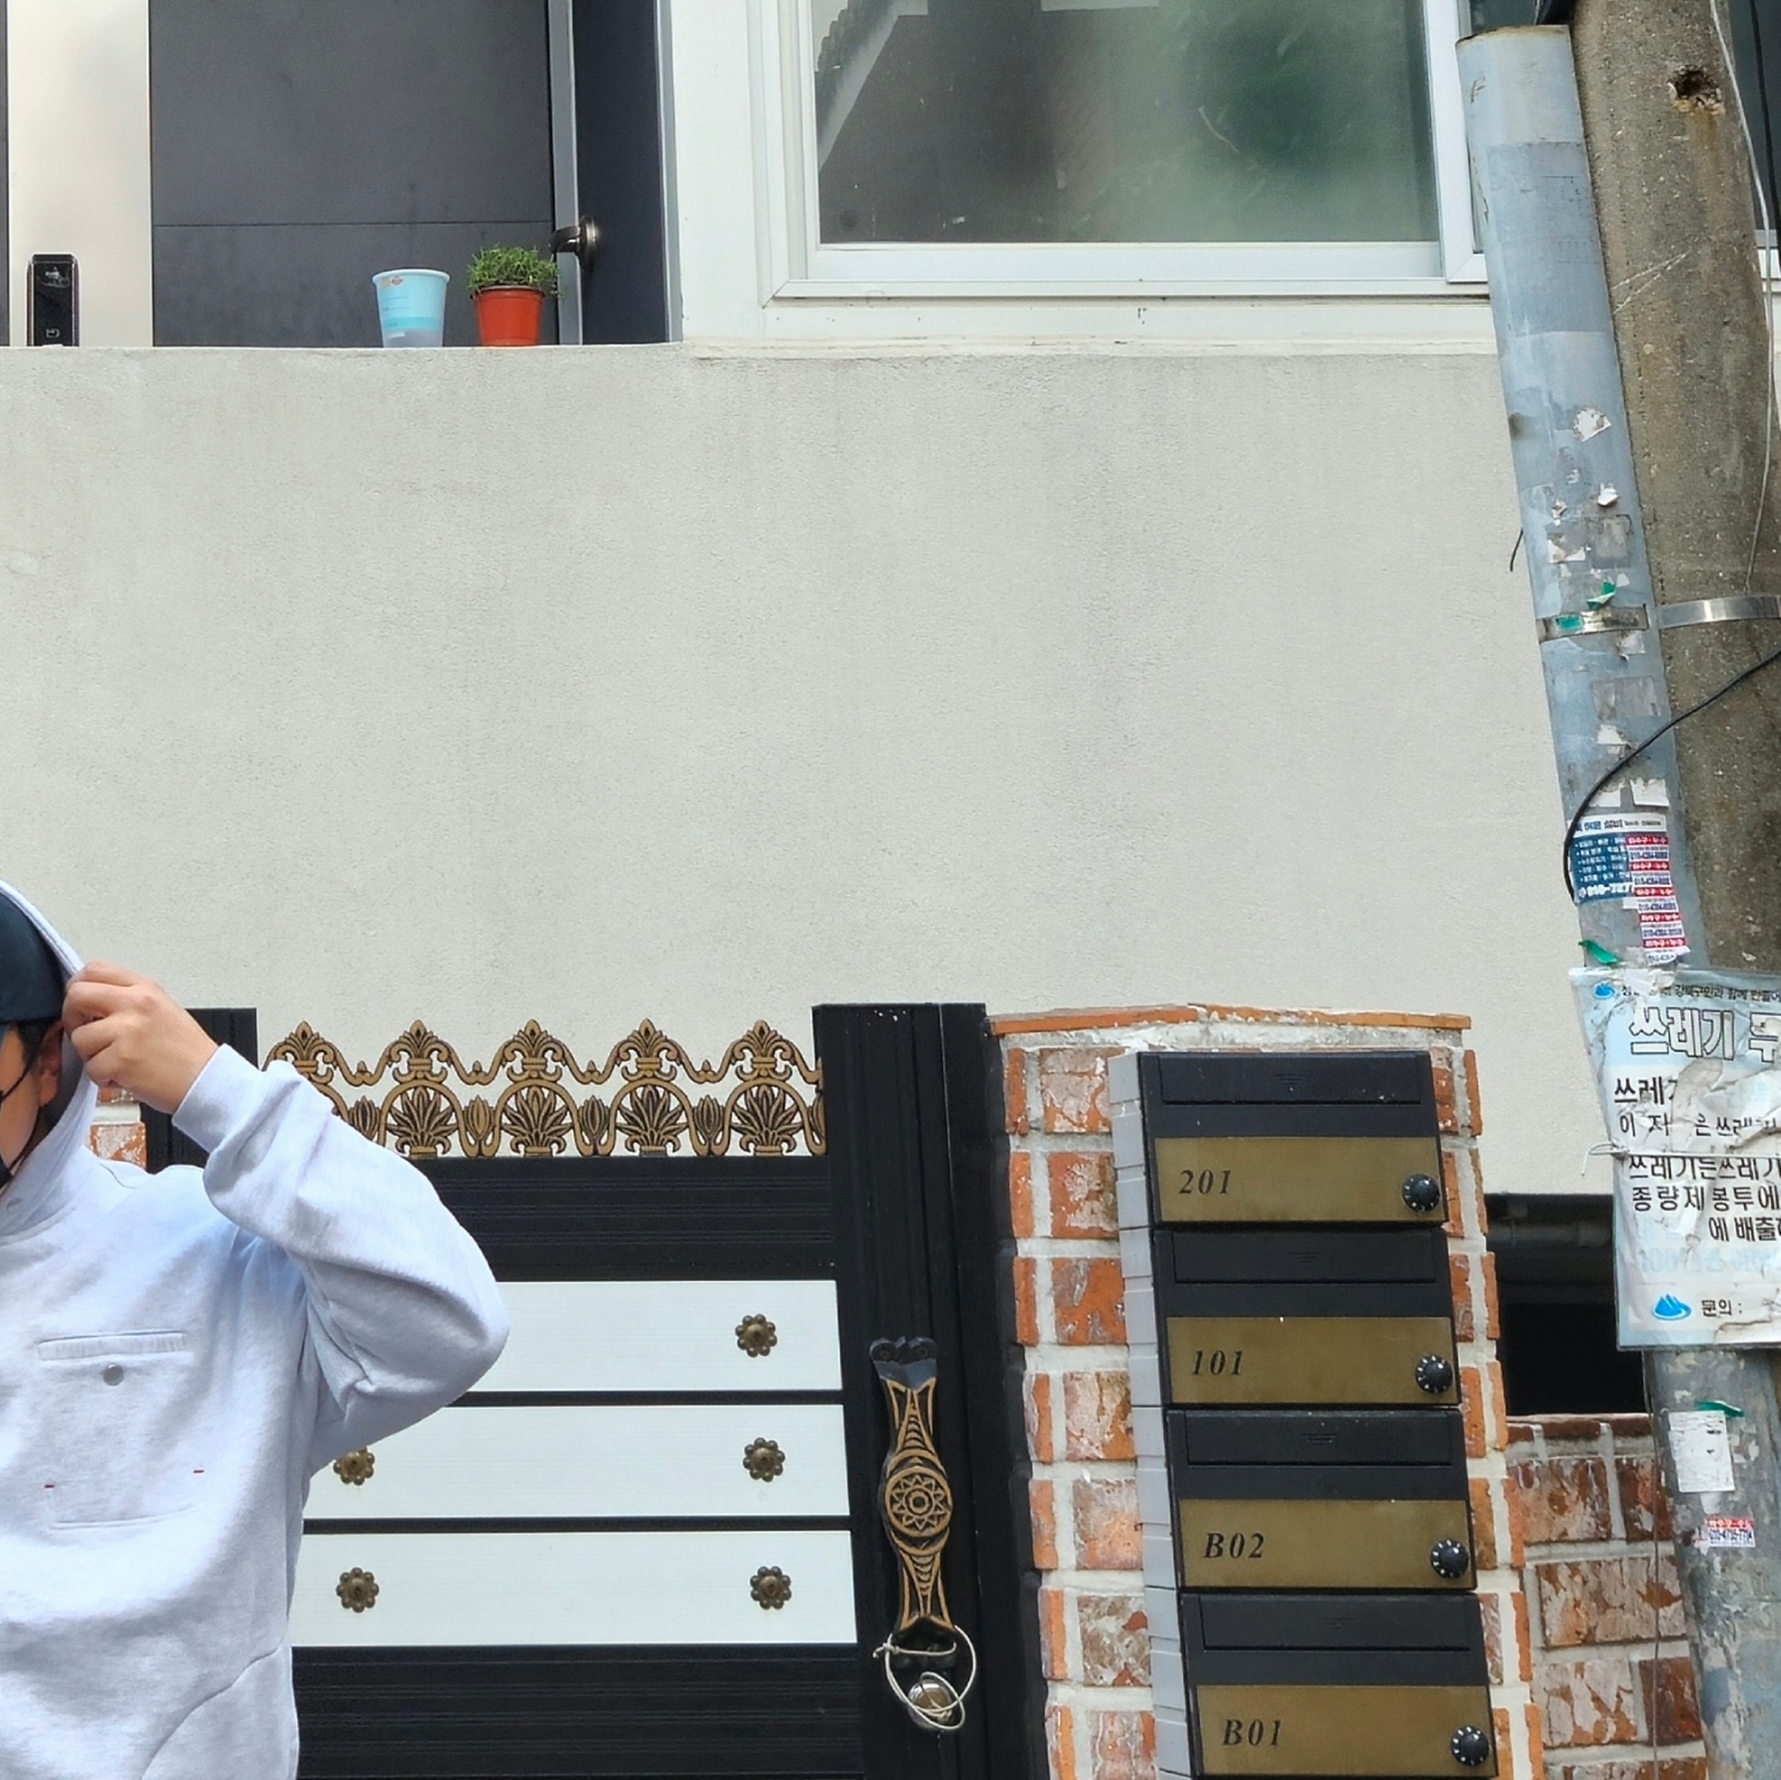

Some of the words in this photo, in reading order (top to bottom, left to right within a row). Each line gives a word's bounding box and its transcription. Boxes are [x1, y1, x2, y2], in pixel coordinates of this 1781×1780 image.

[1629, 1006, 1735, 1061] 쓰레기
[1620, 1112, 1636, 1138] 이
[1179, 1169, 1231, 1194] 201
[1632, 1185, 1705, 1212] 종량제
[1713, 1185, 1780, 1212] 봉투에
[1708, 1217, 1730, 1242] 에
[1192, 1350, 1243, 1376] 101
[1203, 1532, 1264, 1559] B02
[1223, 1719, 1281, 1746] B01
